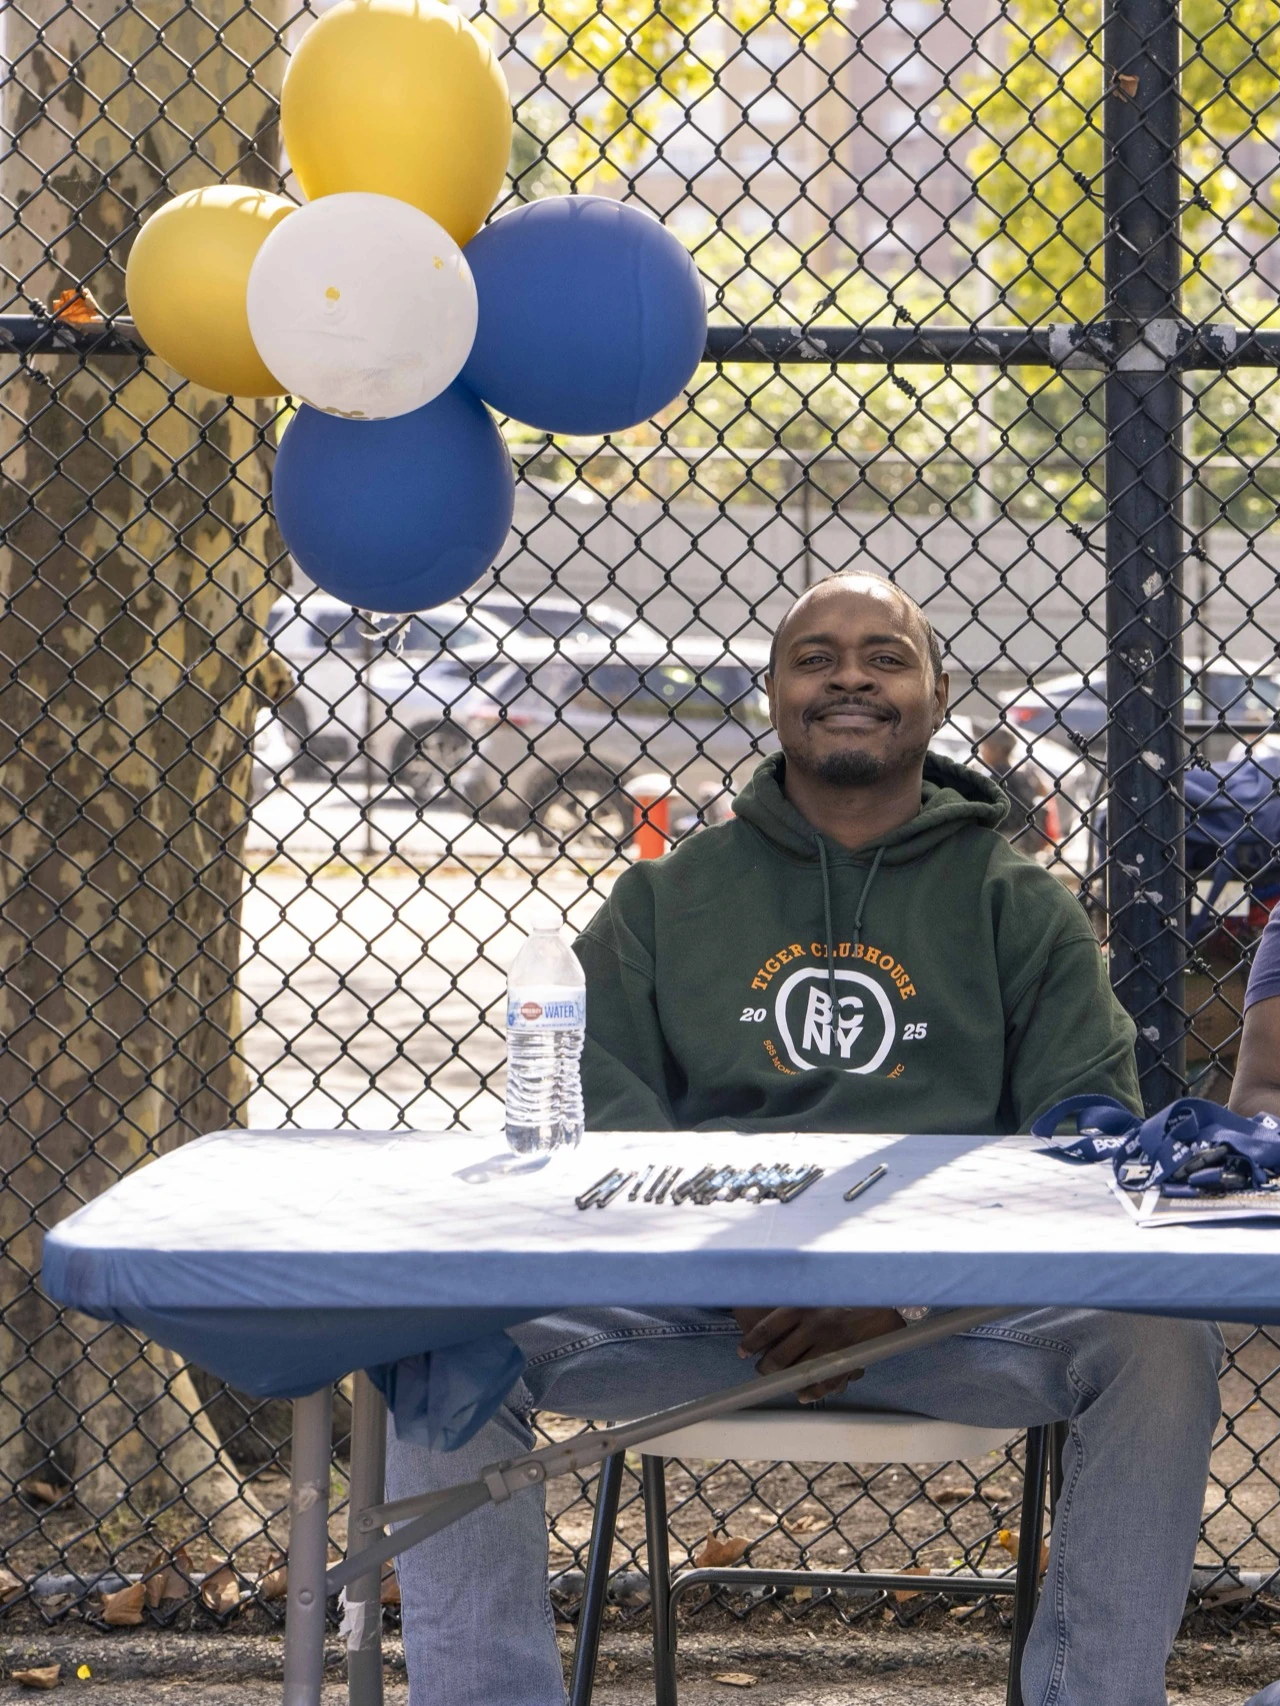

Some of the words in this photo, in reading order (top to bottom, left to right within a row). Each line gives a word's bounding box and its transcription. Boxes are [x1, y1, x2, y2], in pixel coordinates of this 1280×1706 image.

[751, 943, 807, 992] TIGER
[810, 942, 918, 1000] CLUBHOUSE
[544, 1005, 574, 1018] WATER
[739, 1007, 767, 1023] 20
[807, 985, 865, 1029] BC
[801, 1020, 864, 1059] NY
[902, 1022, 928, 1041] 25
[763, 1039, 777, 1056] 565
